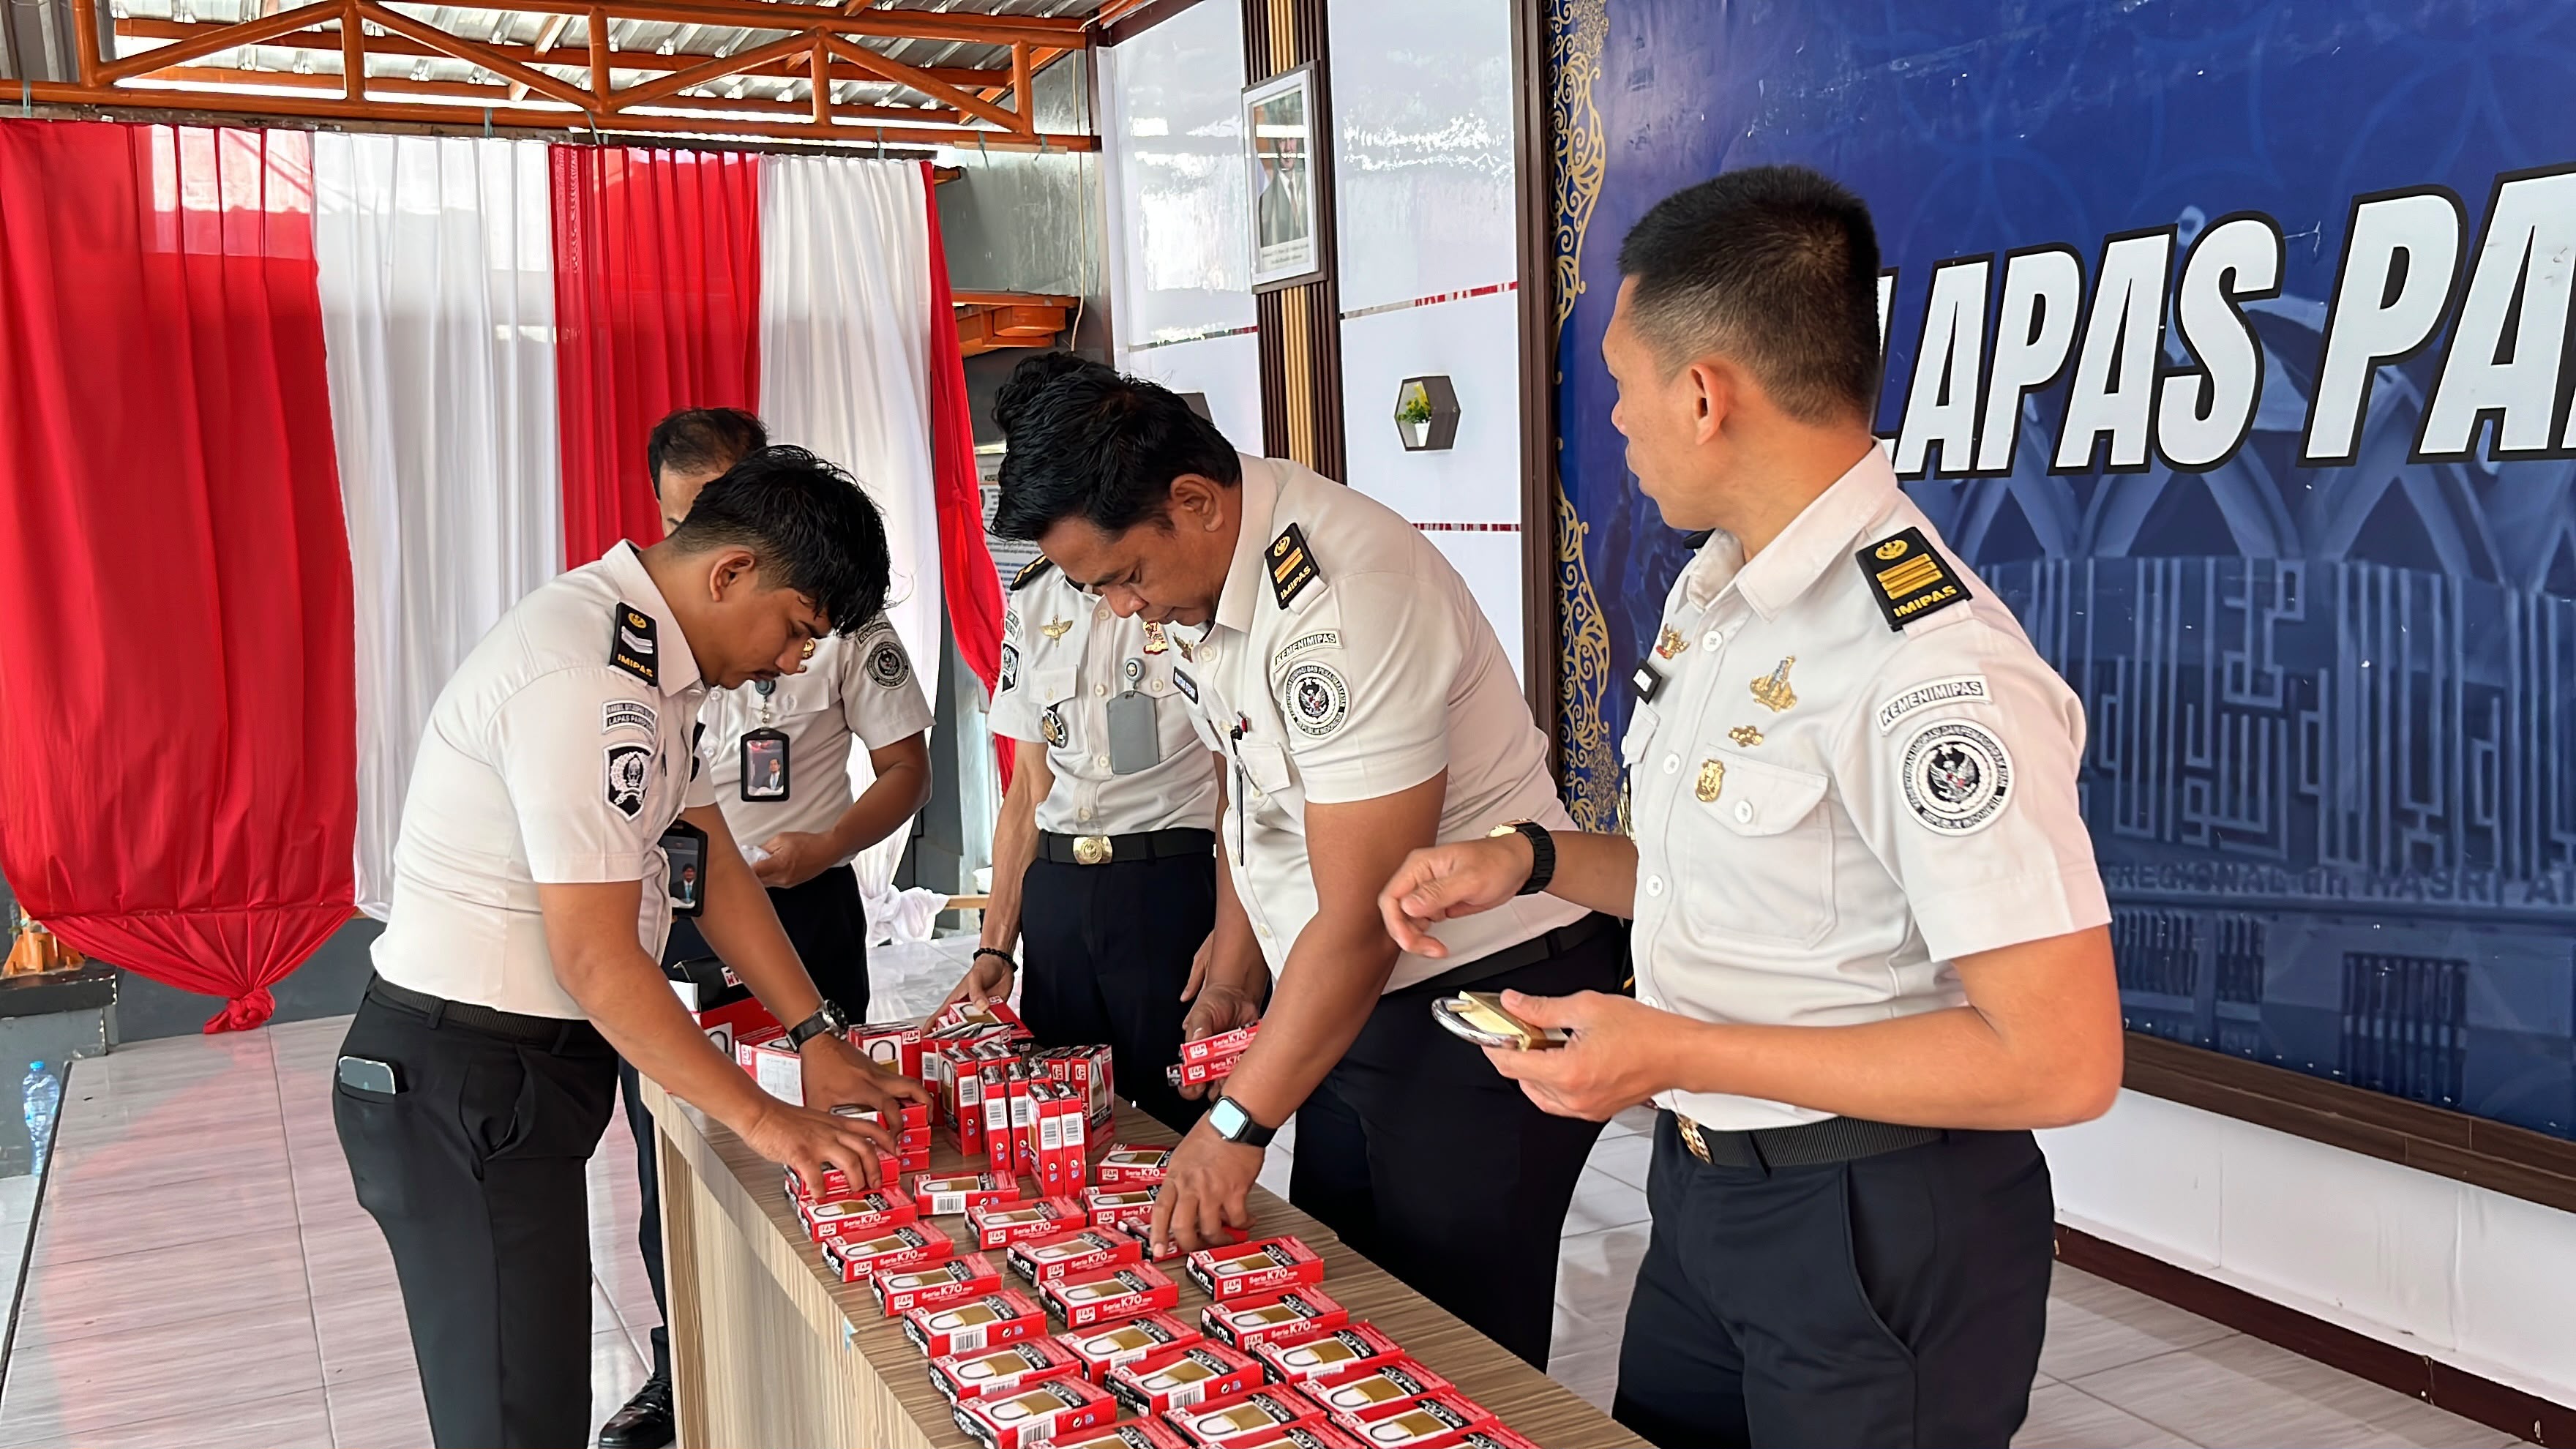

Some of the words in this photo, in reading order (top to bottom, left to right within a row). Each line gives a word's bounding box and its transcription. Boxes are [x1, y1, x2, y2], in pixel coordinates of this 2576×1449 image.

[1875, 212, 2283, 473] APAS
[2302, 164, 2576, 463] PA
[1280, 565, 1311, 600] IMIPAS
[1893, 585, 1957, 617] IMIPAS
[1276, 634, 1336, 665] KEMENIMIPAS
[618, 654, 654, 678] IMIPAS
[1881, 681, 1983, 726] KEMENIMIPAS
[1229, 1030, 1248, 1043] K70
[1141, 1169, 1160, 1177] K70
[1139, 1205, 1153, 1215] K7
[820, 1224, 836, 1232] IFAM
[861, 1213, 881, 1224] K70
[1013, 1228, 1030, 1236] Serie
[1030, 1221, 1052, 1233] K70
[855, 1262, 872, 1270] IFAM
[896, 1250, 918, 1262] K70
[1071, 1259, 1088, 1268] Serie
[1088, 1251, 1108, 1264] K70
[1225, 1279, 1240, 1287] IFAM
[1267, 1268, 1288, 1281] K70
[896, 1295, 913, 1304] IFAM
[940, 1283, 963, 1296] K70
[1103, 1303, 1121, 1312] Serie
[1120, 1295, 1142, 1308] K70
[1216, 1326, 1228, 1341] K70
[1289, 1320, 1311, 1334] K70
